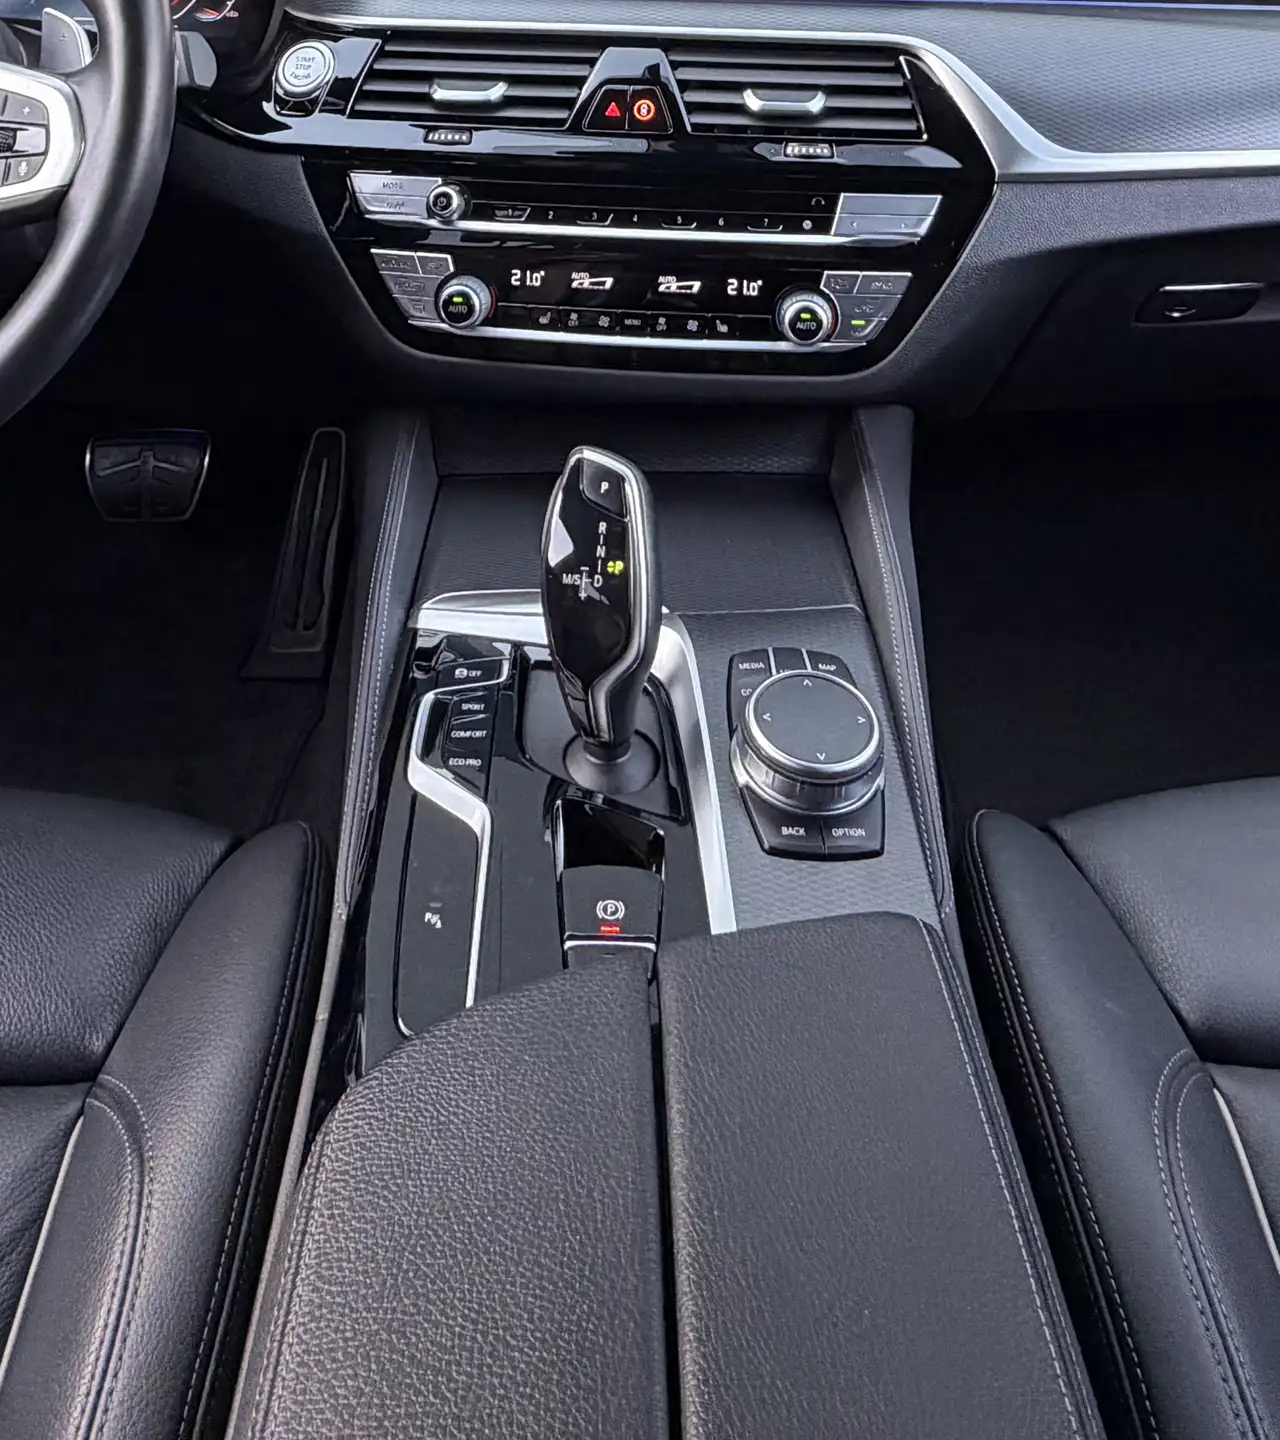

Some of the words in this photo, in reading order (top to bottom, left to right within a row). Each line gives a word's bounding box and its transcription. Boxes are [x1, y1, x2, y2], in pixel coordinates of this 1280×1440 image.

[296, 56, 316, 64] START
[547, 210, 554, 220] 2
[591, 212, 598, 220] 3
[632, 214, 638, 222] 4
[676, 215, 682, 224] 5
[718, 217, 724, 226] 6
[763, 218, 769, 227] 7
[571, 272, 590, 280] AUTO
[658, 275, 677, 283] AUTO
[448, 305, 468, 313] AUTO
[624, 318, 642, 326] MENU
[796, 321, 817, 330] AUTO
[656, 323, 667, 331] OFF
[600, 481, 609, 494] P
[598, 521, 607, 535] R
[596, 545, 605, 558] N
[562, 573, 581, 585] M/S
[593, 575, 602, 587] D
[738, 662, 765, 670] MEDIA
[818, 663, 836, 671] MAP
[461, 703, 485, 711] SPORT
[450, 730, 487, 738] COMFORT
[448, 757, 465, 766] ECO
[465, 758, 482, 766] PRO
[781, 826, 806, 836] BACK
[832, 827, 866, 837] OPTION
